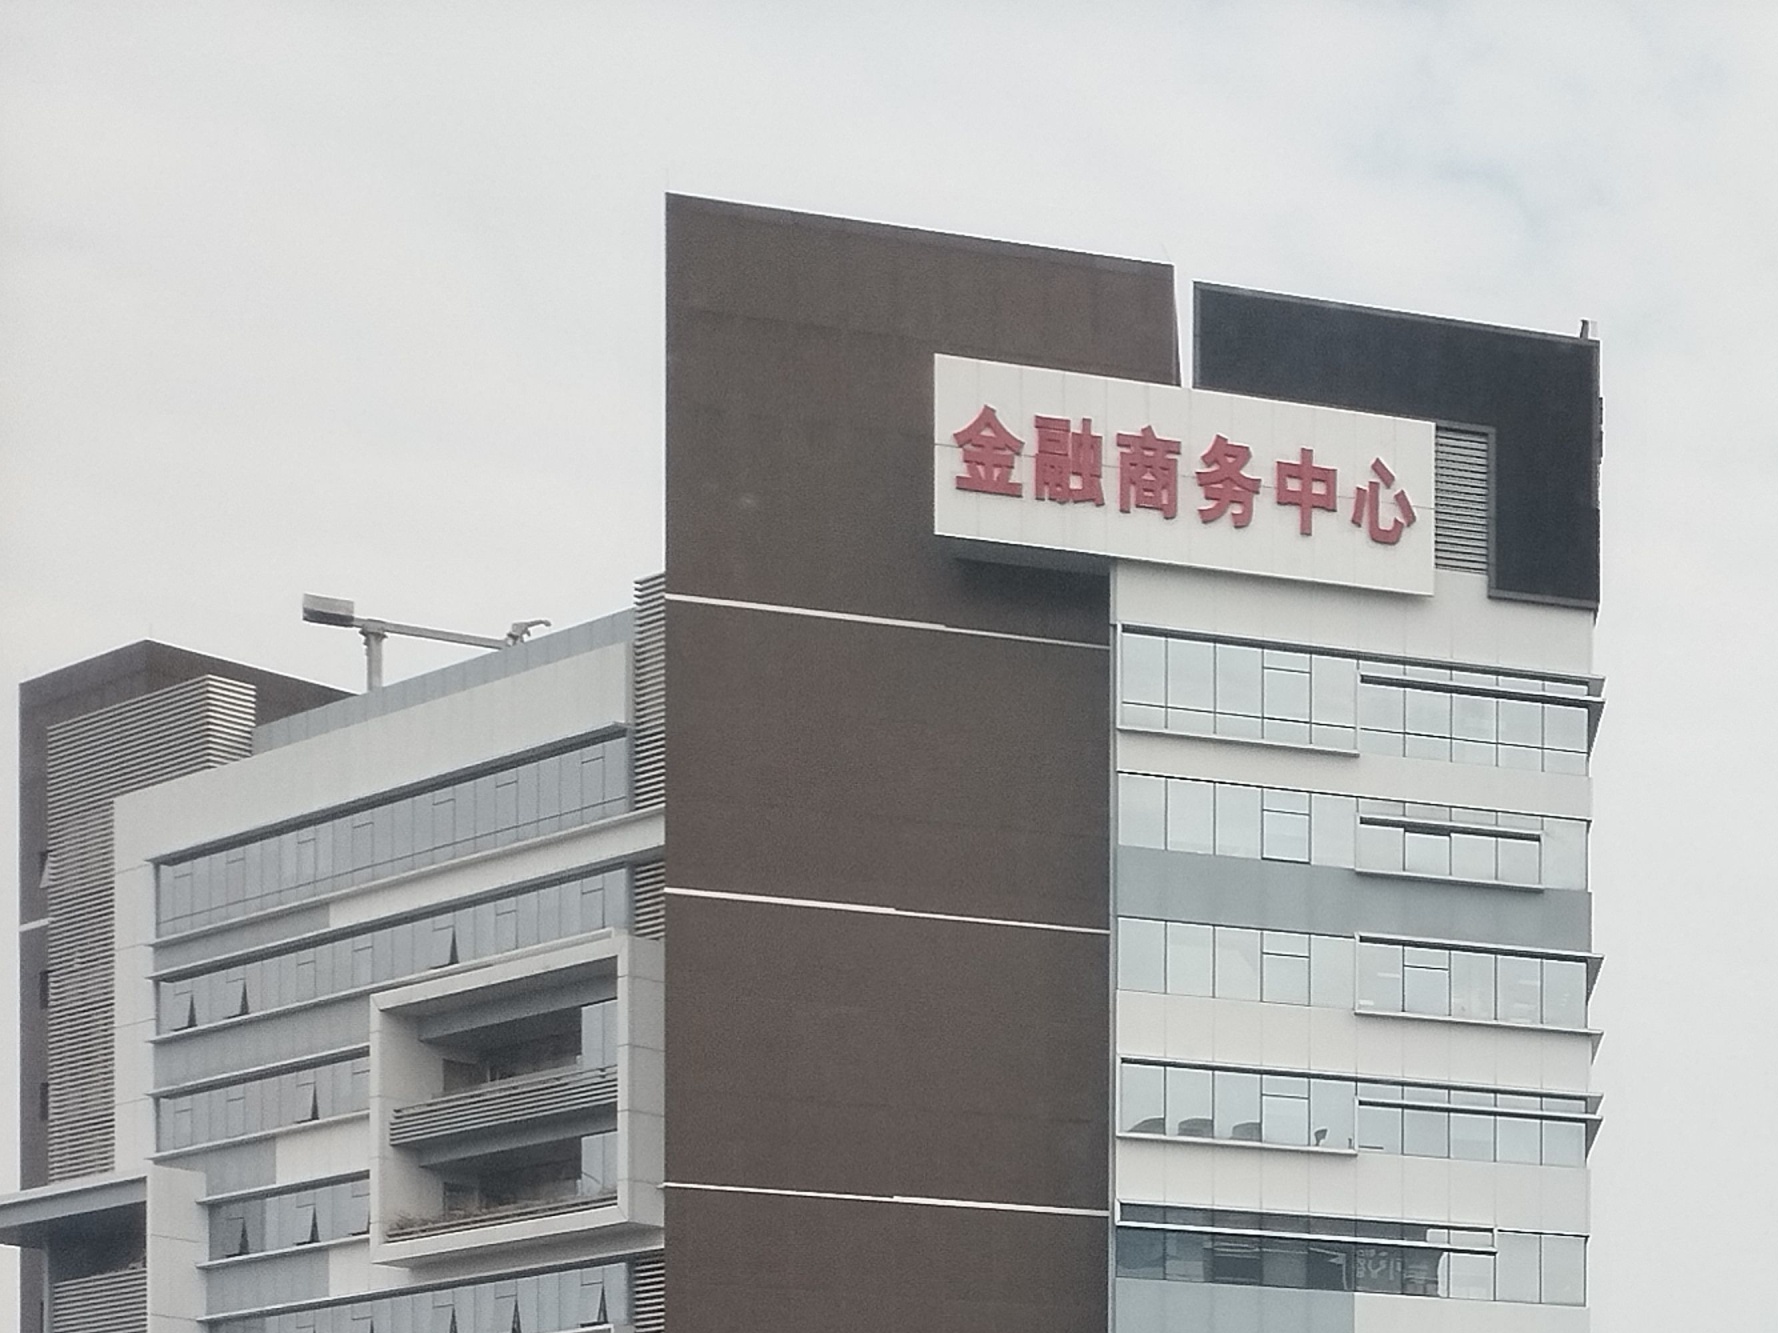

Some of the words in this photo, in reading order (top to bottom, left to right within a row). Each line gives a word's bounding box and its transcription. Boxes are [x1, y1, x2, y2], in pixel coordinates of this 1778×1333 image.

[953, 404, 1418, 546] 金融商务中心
